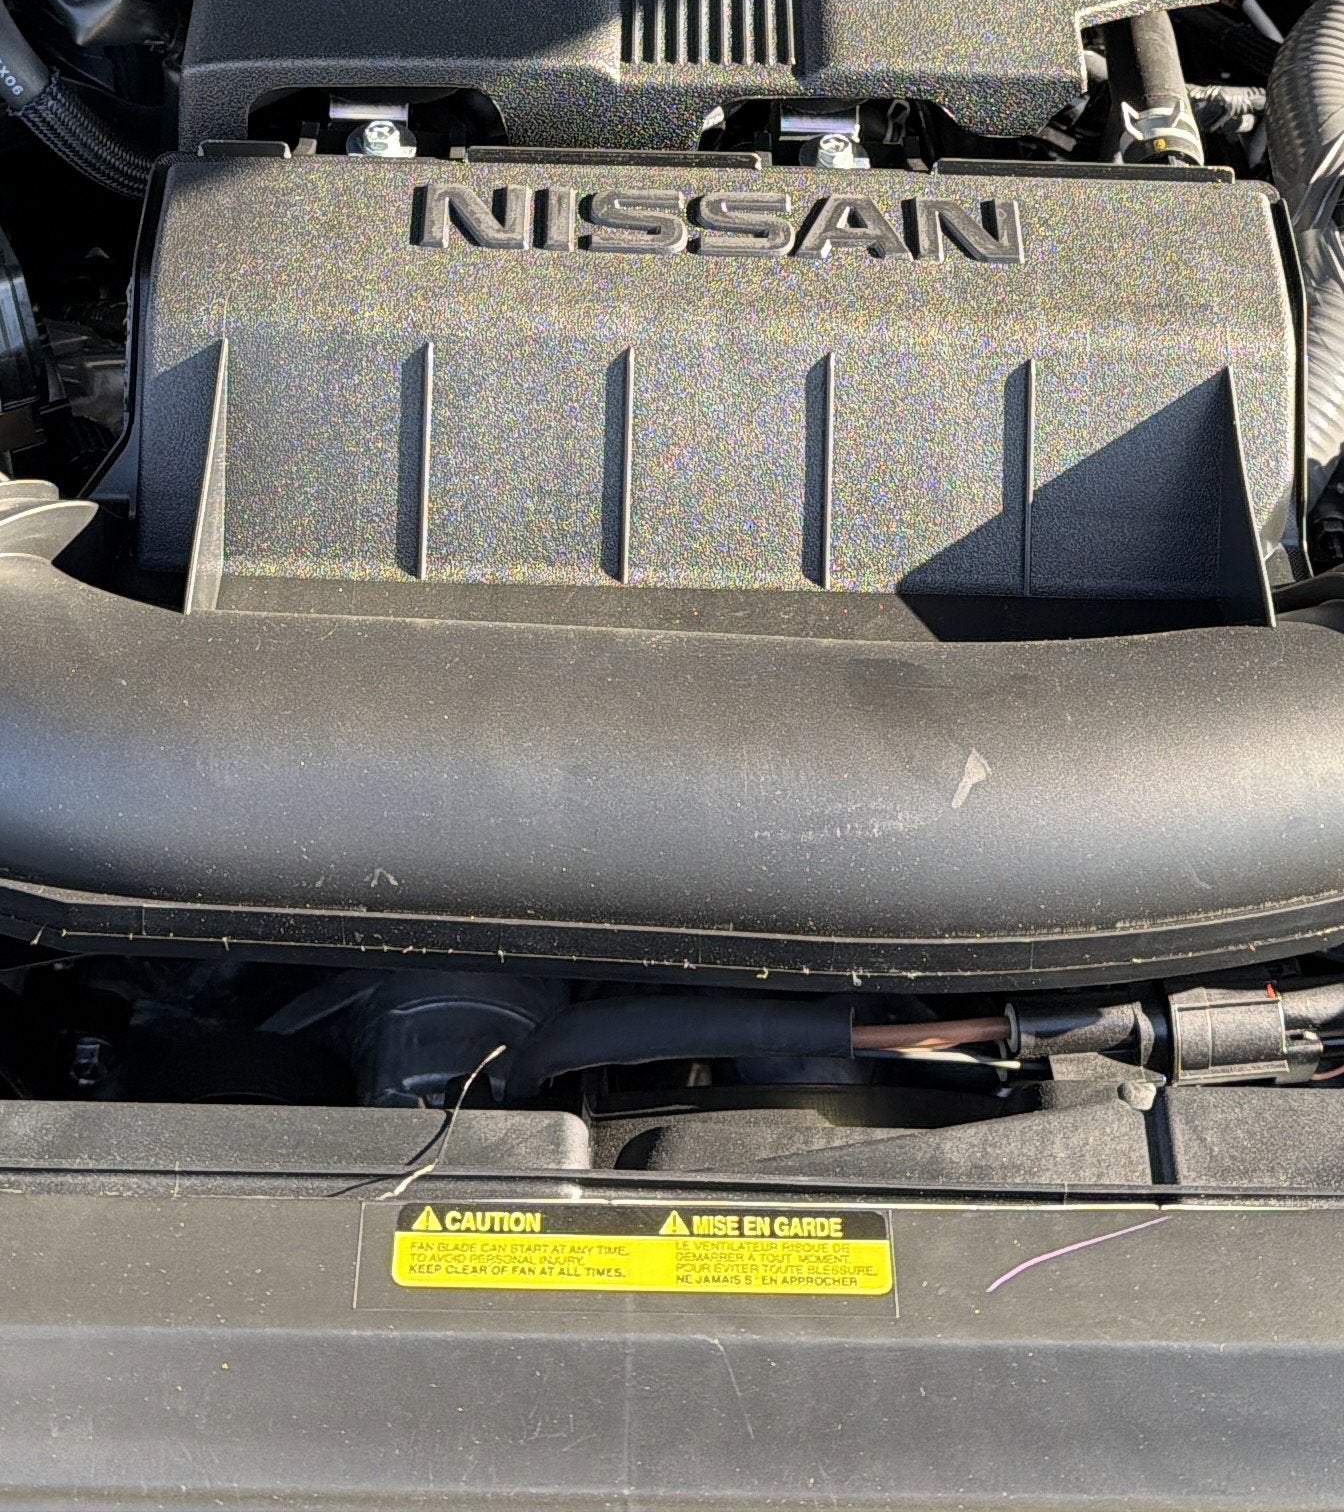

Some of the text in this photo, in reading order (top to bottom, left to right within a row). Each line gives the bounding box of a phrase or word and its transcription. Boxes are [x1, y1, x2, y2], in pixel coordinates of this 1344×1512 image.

[410, 184, 1025, 264] NISSAN
[444, 1210, 543, 1233] CAUTION
[693, 1215, 844, 1238] MISE EN GARDE
[410, 1242, 434, 1251] FAN
[437, 1242, 476, 1252] BLADE
[481, 1243, 507, 1253] CAN
[510, 1244, 549, 1253] START
[552, 1244, 566, 1254] AT
[569, 1245, 594, 1256] ANY
[675, 1240, 850, 1254] LE VENTILATEUR RISQUE DE
[410, 1253, 426, 1262] TO
[429, 1254, 466, 1263] AVOID
[470, 1254, 536, 1265] PERSONAL
[760, 1253, 791, 1263] TOUT
[409, 1264, 441, 1274] KEEP
[445, 1265, 487, 1275] CLEAR
[491, 1266, 507, 1275] OF
[512, 1266, 536, 1275] FAN
[539, 1266, 554, 1276] AT
[559, 1267, 581, 1277] ALL
[676, 1263, 711, 1273] POUR
[761, 1264, 803, 1275] TOUTE
[676, 1274, 692, 1284] NE
[695, 1275, 741, 1285] JAMAIS
[762, 1276, 778, 1285] EN
[782, 1277, 857, 1286] APPROCHER
